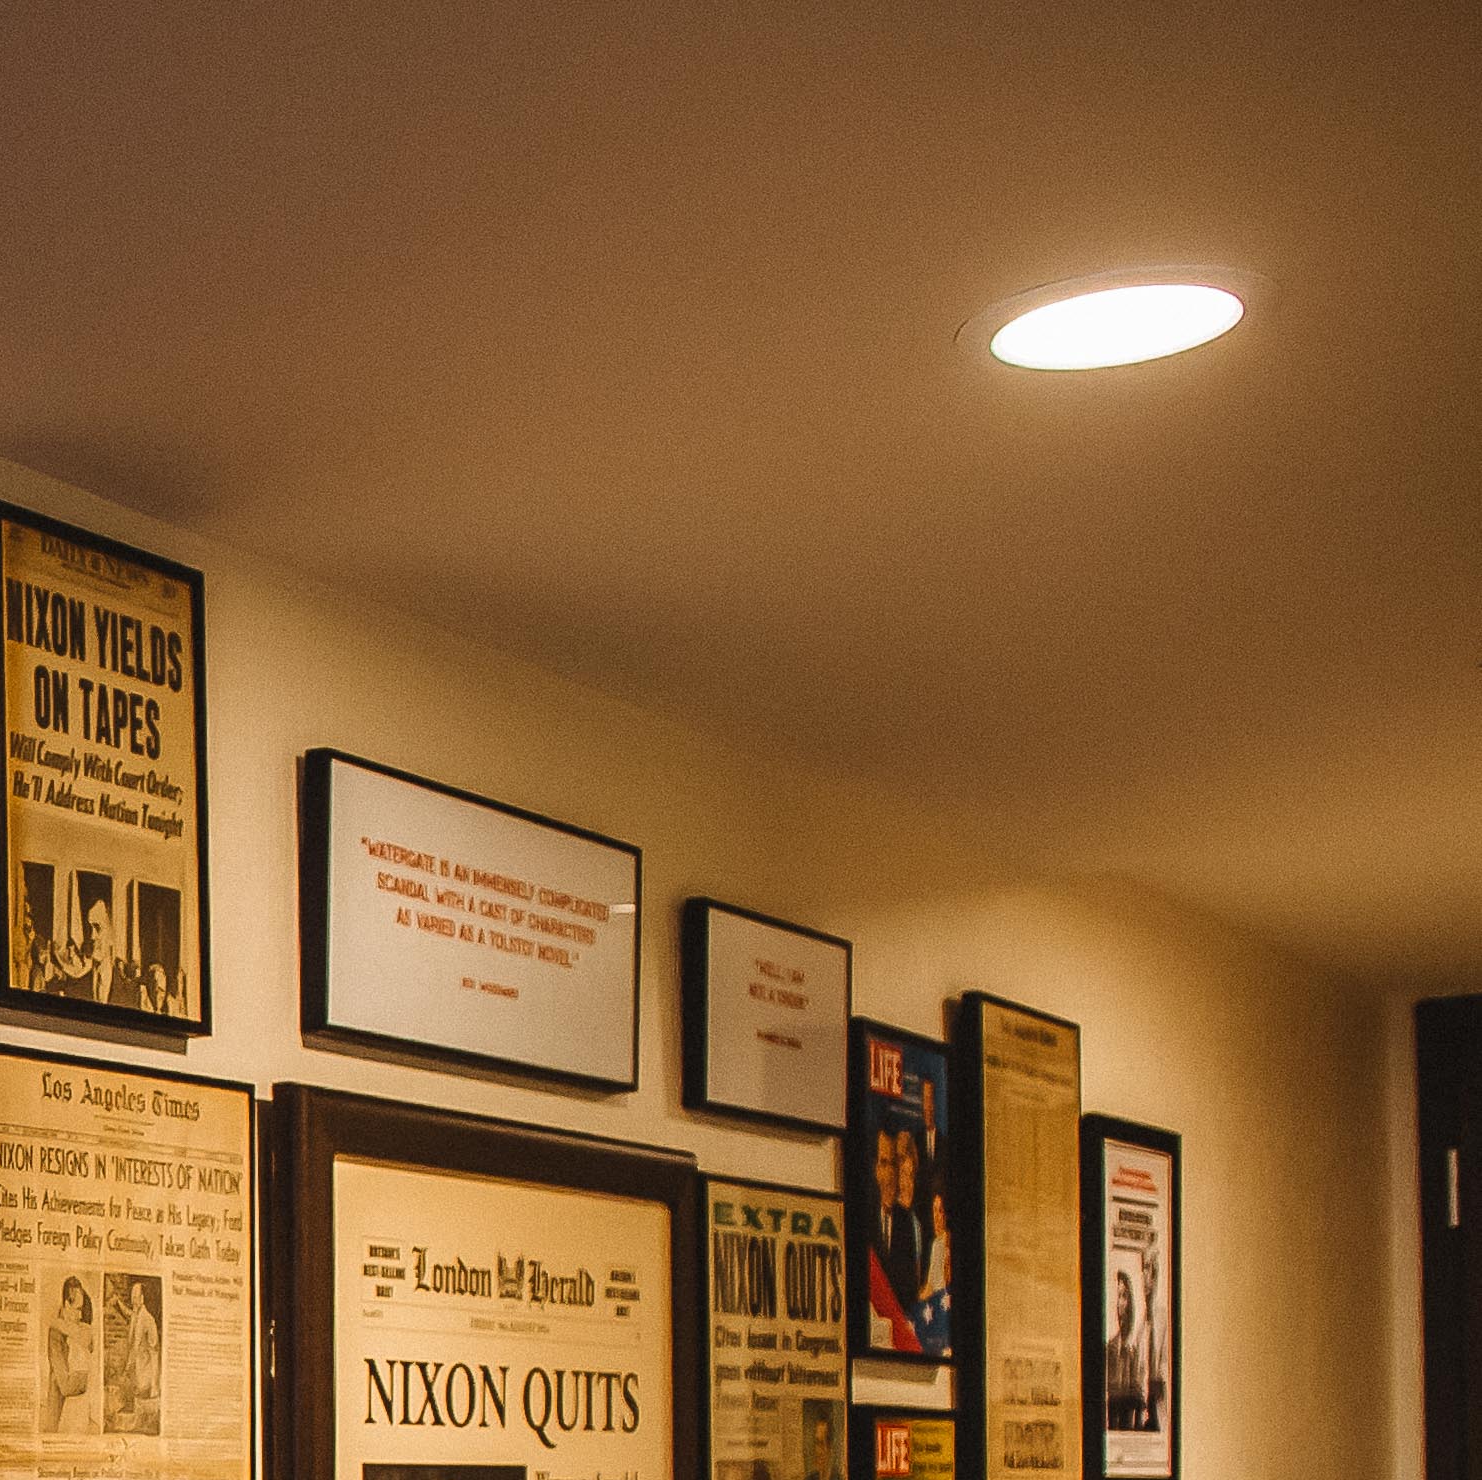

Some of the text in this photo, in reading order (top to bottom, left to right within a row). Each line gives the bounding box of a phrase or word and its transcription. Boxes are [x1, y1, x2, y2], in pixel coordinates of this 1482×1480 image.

[6, 577, 183, 692] NIXON YIELDS
[34, 665, 161, 760] ON TAPES
[42, 1071, 200, 1121] Los Angeles Times
[871, 1047, 902, 1093] LIFE
[39, 1146, 88, 1178] RESIGNS
[95, 1154, 107, 1179] IN
[177, 1164, 193, 1189] OF
[714, 1202, 839, 1240] EXTRA
[412, 1247, 492, 1297] London
[528, 1259, 596, 1309] Herald
[364, 1358, 639, 1449] NIXON QUITS
